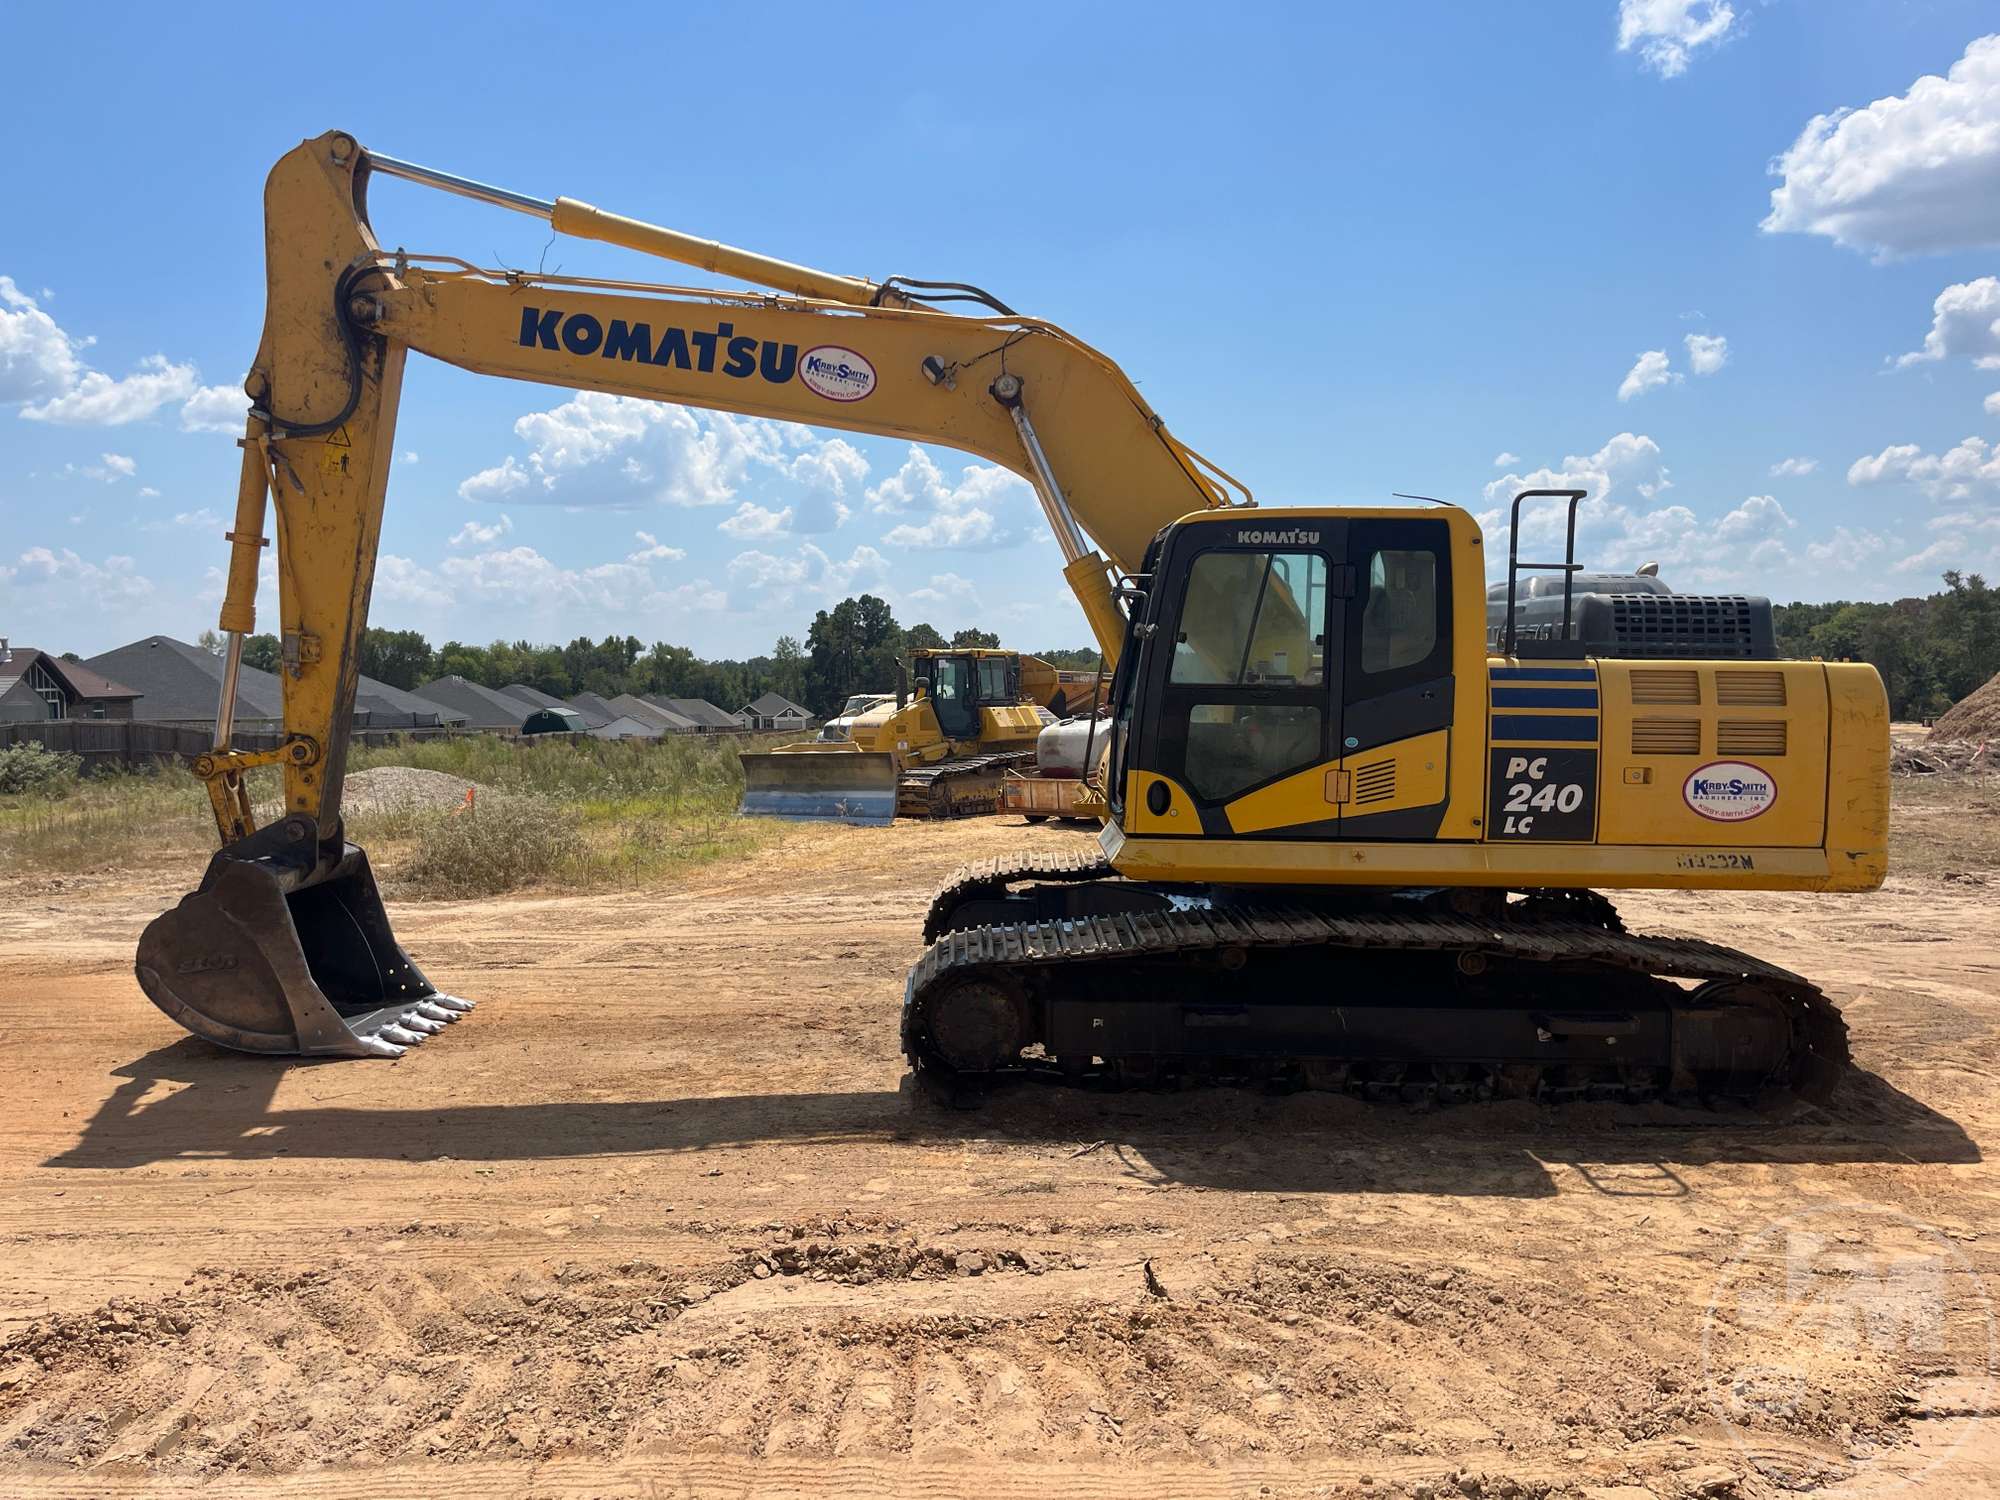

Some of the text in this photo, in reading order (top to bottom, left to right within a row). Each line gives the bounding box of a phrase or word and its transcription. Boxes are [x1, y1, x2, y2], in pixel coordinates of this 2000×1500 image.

[519, 306, 798, 384] KOMATSU
[807, 356, 869, 382] KIRBY-SMITH
[1237, 528, 1320, 545] KOMATSU
[1505, 757, 1548, 780] PC
[1693, 779, 1767, 796] KIRBY-SMITH
[1503, 783, 1584, 814] 240
[1698, 803, 1762, 817] KIRBY-SMITH.COM
[1503, 816, 1534, 834] LC
